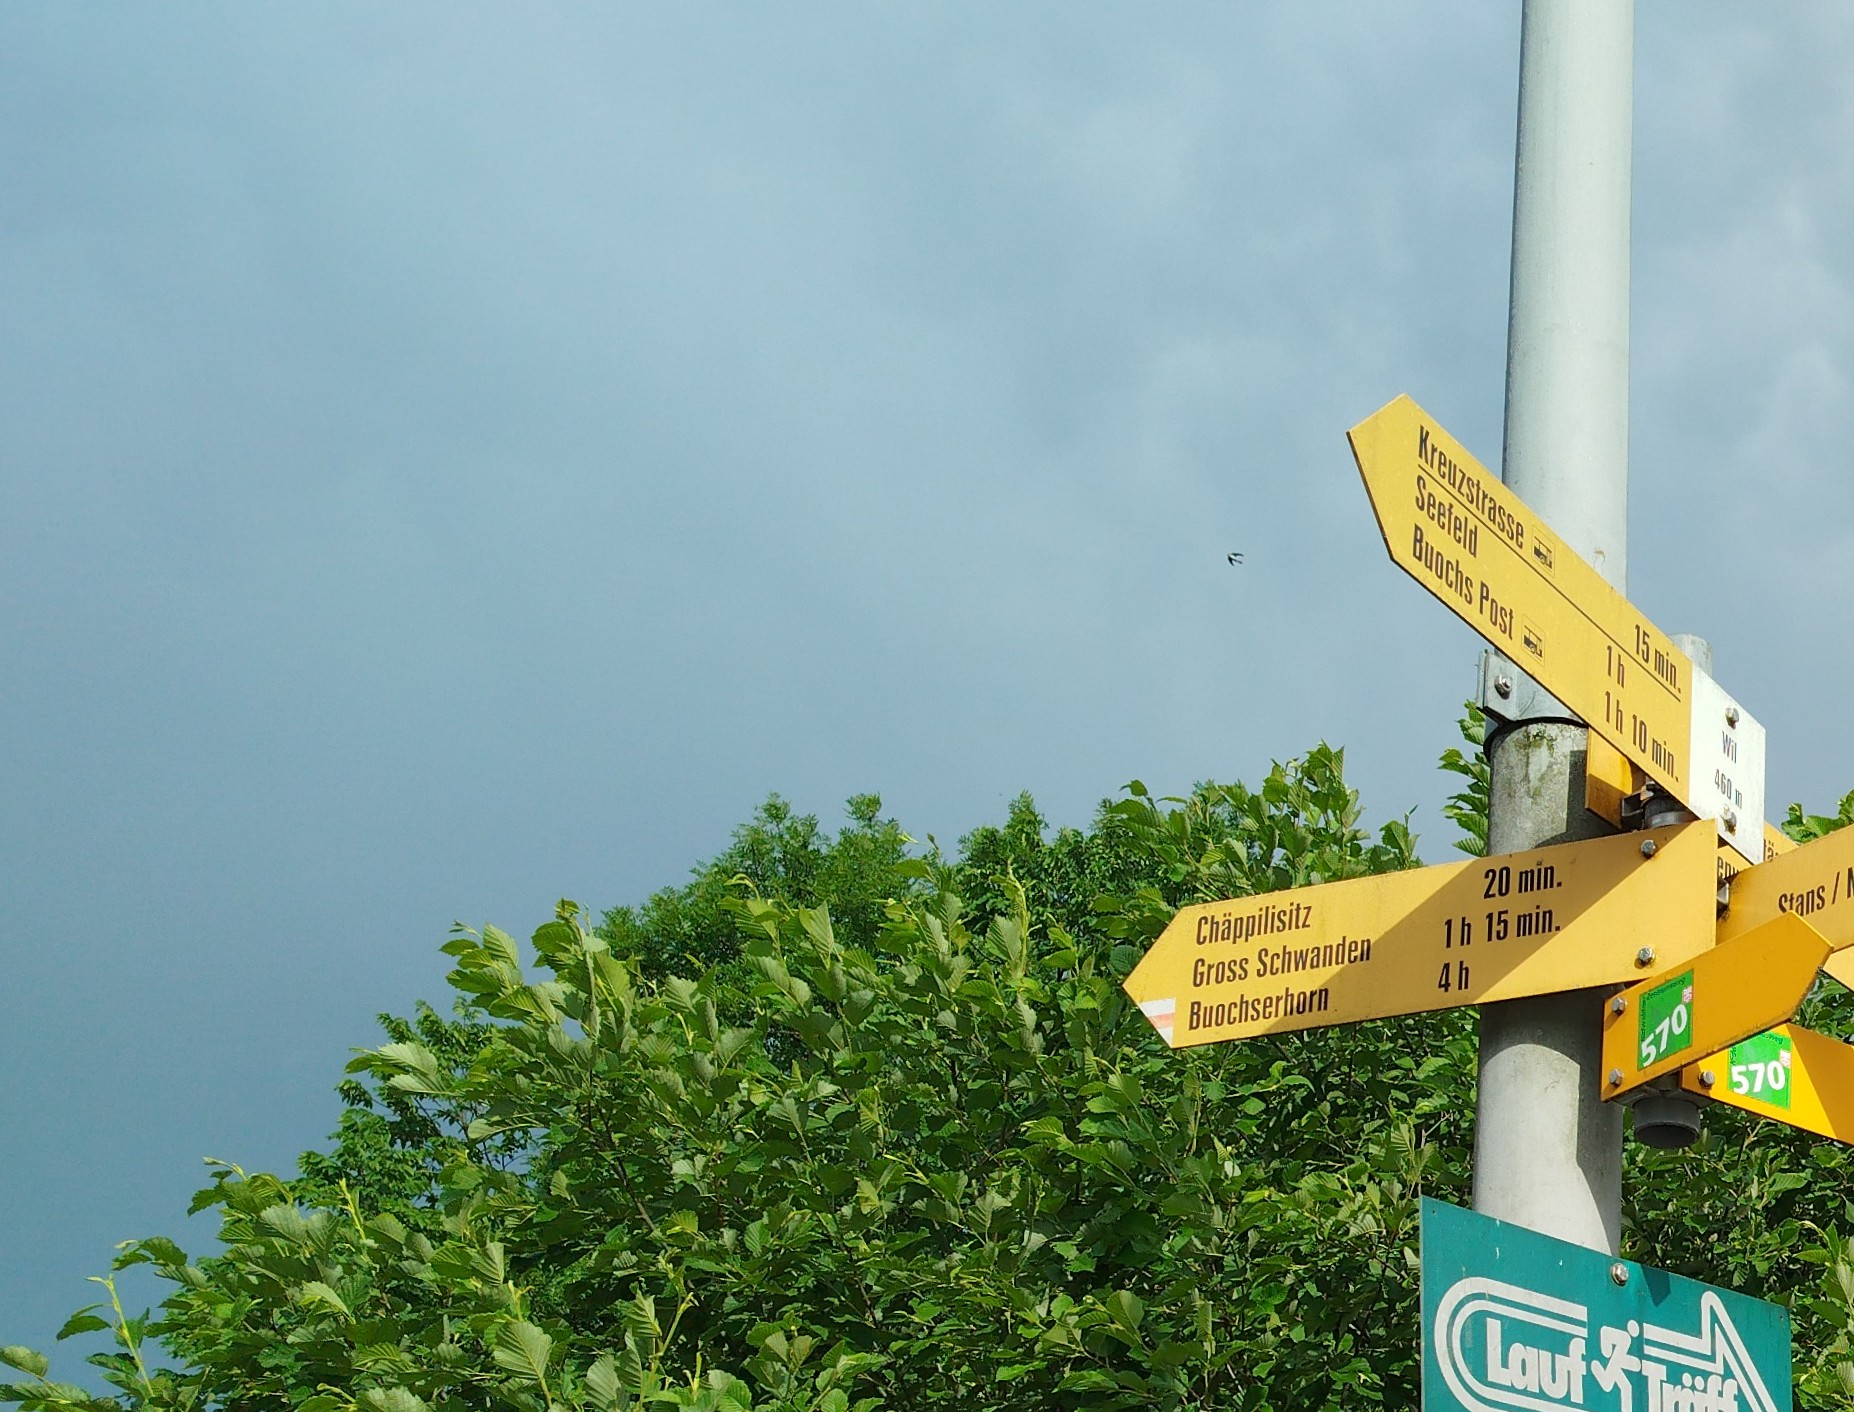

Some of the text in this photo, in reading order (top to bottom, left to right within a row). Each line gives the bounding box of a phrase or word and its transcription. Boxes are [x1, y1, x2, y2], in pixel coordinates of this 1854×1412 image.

[1415, 474, 1478, 558] Seefeld
[1616, 653, 1625, 688] h
[1418, 424, 1681, 694] Kreuzstrasse 15 min.
[1412, 523, 1473, 605] Buochs
[1479, 581, 1514, 640] Post
[1615, 699, 1623, 734] h
[1632, 714, 1648, 754] 10
[1651, 737, 1679, 783] min.
[1722, 730, 1737, 764] Wil
[1714, 768, 1743, 810] 460 m
[1196, 859, 1562, 945] Chäppilisitz 20 min.
[1778, 884, 1826, 917] Stans
[1831, 871, 1841, 905] /
[1192, 904, 1561, 988] Gross Schwanden 1 h 15 min.
[1188, 960, 1469, 1031] Buochserhorn 4 h
[1640, 1003, 1688, 1068] 570
[1731, 1060, 1786, 1095] 570
[1486, 1317, 1587, 1404] Lauf
